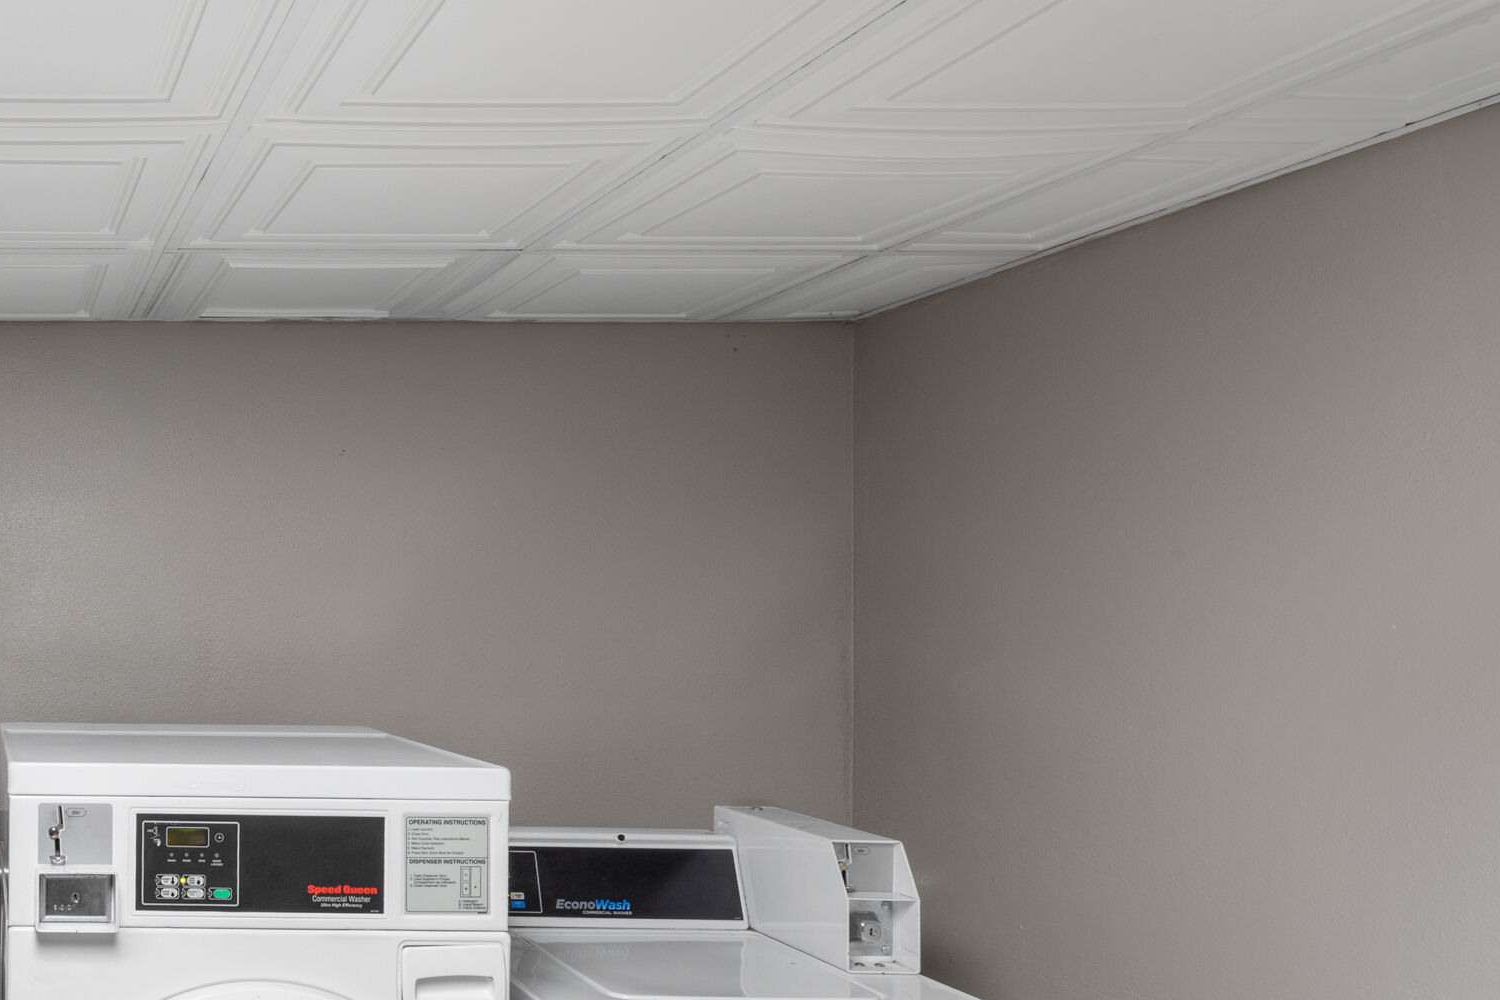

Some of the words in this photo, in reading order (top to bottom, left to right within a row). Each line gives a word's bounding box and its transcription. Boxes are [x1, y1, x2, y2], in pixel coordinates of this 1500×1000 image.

[307, 884, 342, 895] Speed
[343, 884, 378, 895] Queen
[348, 895, 371, 903] Washer
[555, 899, 631, 910] EconoWash
